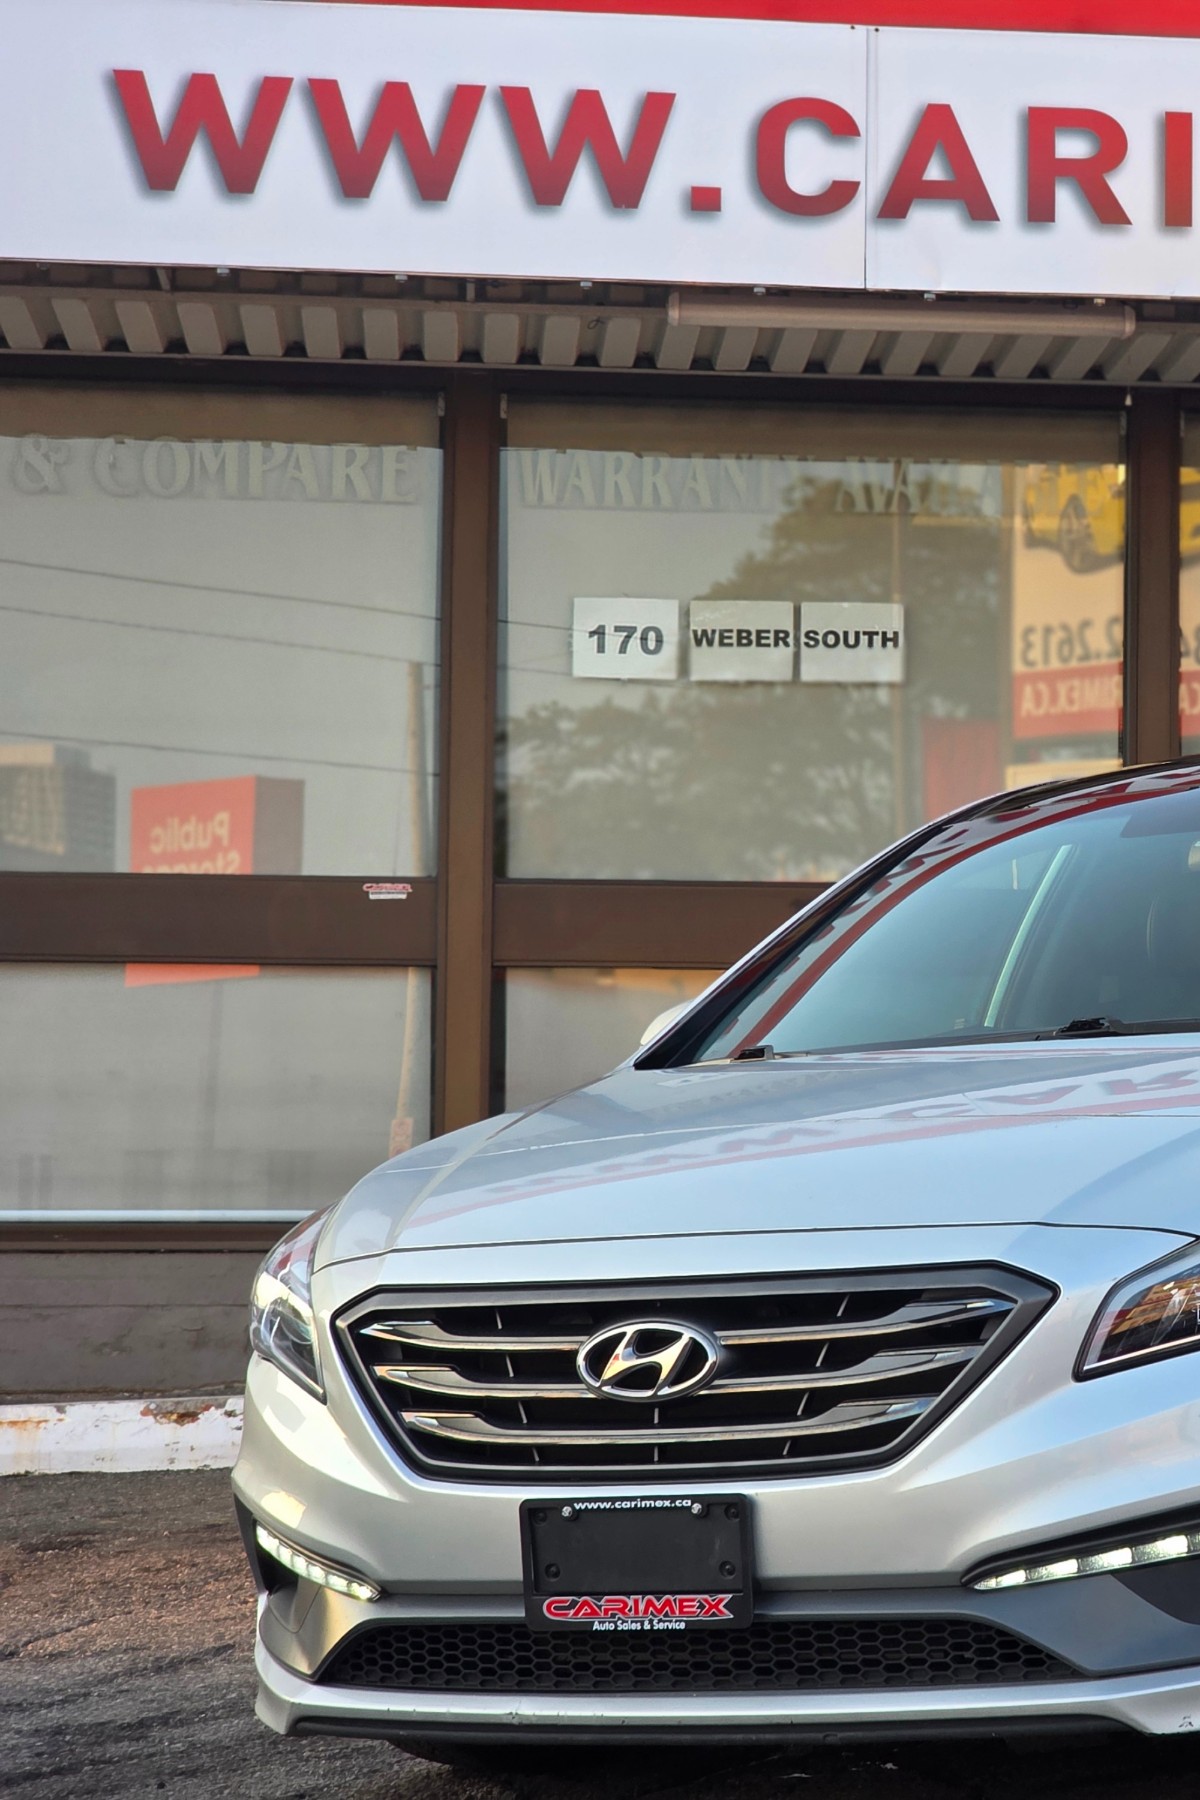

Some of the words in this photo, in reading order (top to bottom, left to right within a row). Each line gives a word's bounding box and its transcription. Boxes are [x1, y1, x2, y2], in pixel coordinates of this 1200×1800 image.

[95, 435, 419, 503] COMPARE
[587, 624, 665, 656] 170
[692, 628, 791, 649] WEBER
[803, 629, 900, 650] SOUTH
[573, 1498, 692, 1511] www.carimex.ca
[544, 1595, 734, 1619] CARIMEX
[593, 1620, 615, 1632] Auto
[617, 1620, 641, 1631] Sales
[643, 1620, 651, 1630] &
[653, 1619, 686, 1630] Service
